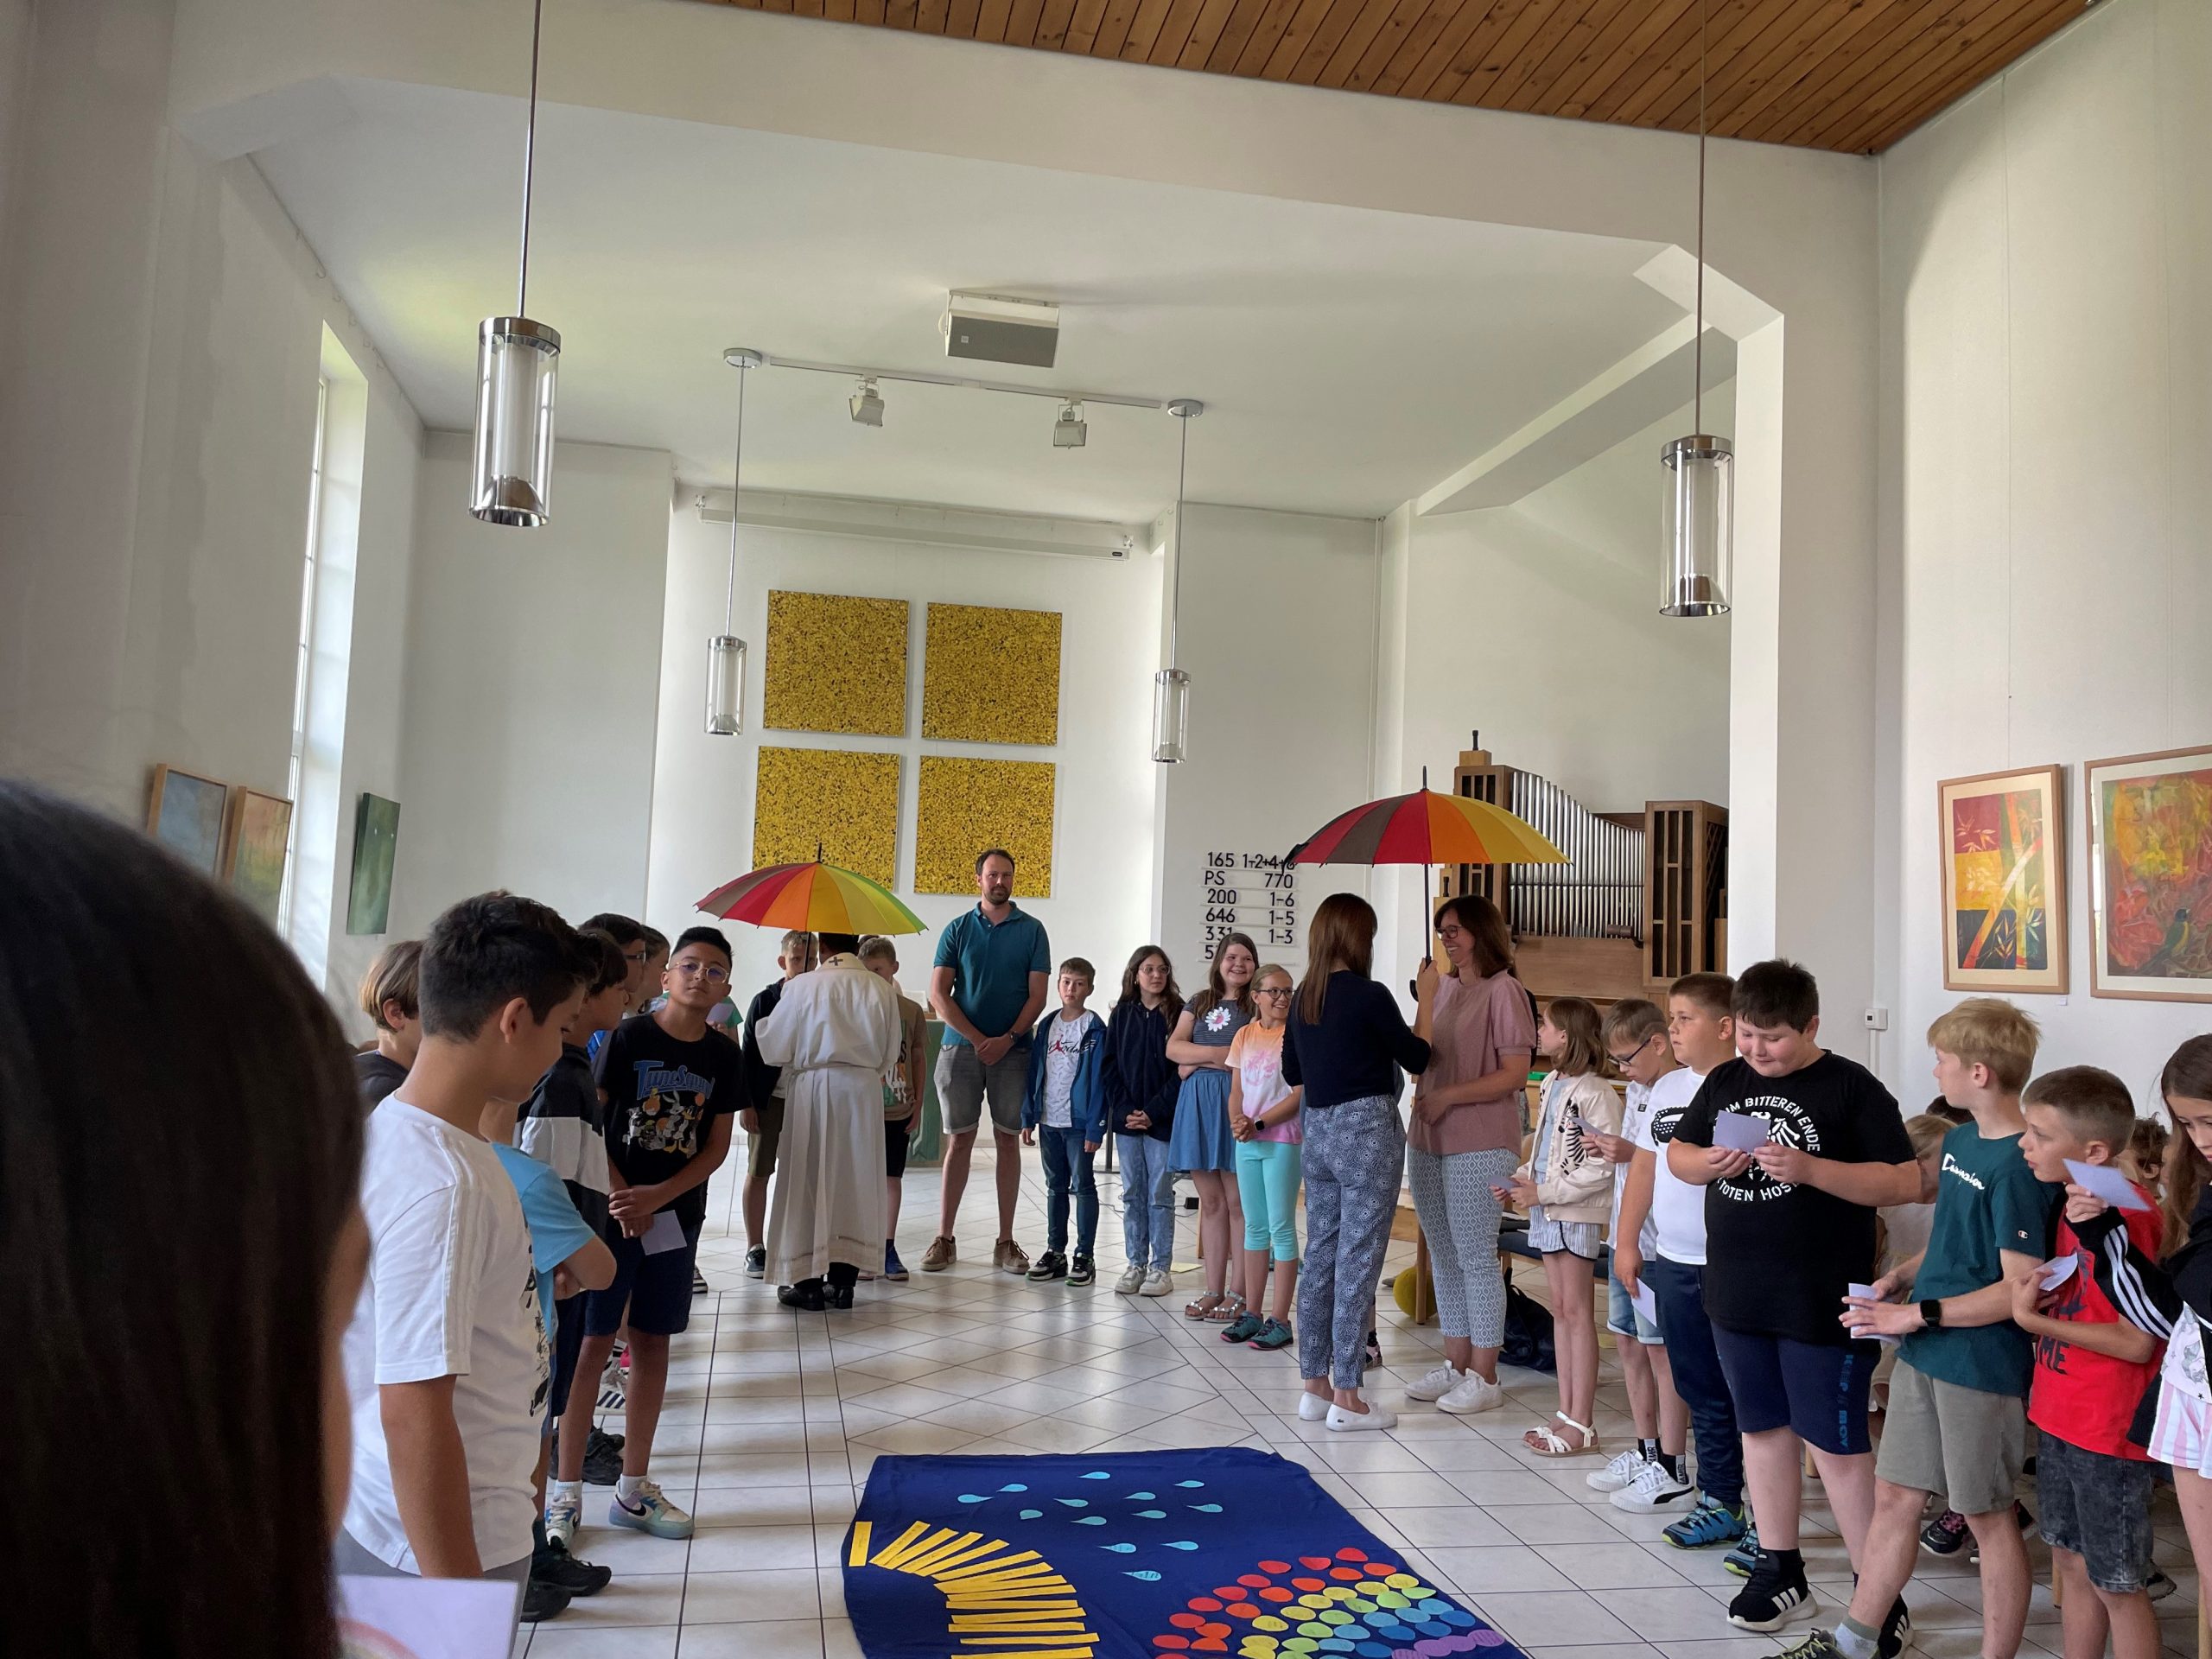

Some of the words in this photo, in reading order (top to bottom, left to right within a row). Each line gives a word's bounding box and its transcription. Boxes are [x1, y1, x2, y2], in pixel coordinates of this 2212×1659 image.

[1207, 851, 1235, 868] 165
[1205, 870, 1225, 885] PS
[1265, 873, 1294, 889] 770
[1207, 888, 1236, 904] 200
[1270, 892, 1294, 907] 1-6
[1205, 907, 1236, 923] 646
[1268, 910, 1294, 925] 1-5
[1268, 929, 1293, 944] 1-3
[1745, 1096, 1803, 1117] BITTEREN
[1797, 1116, 1821, 1152] ENDE
[1719, 1179, 1754, 1202] TOTEN
